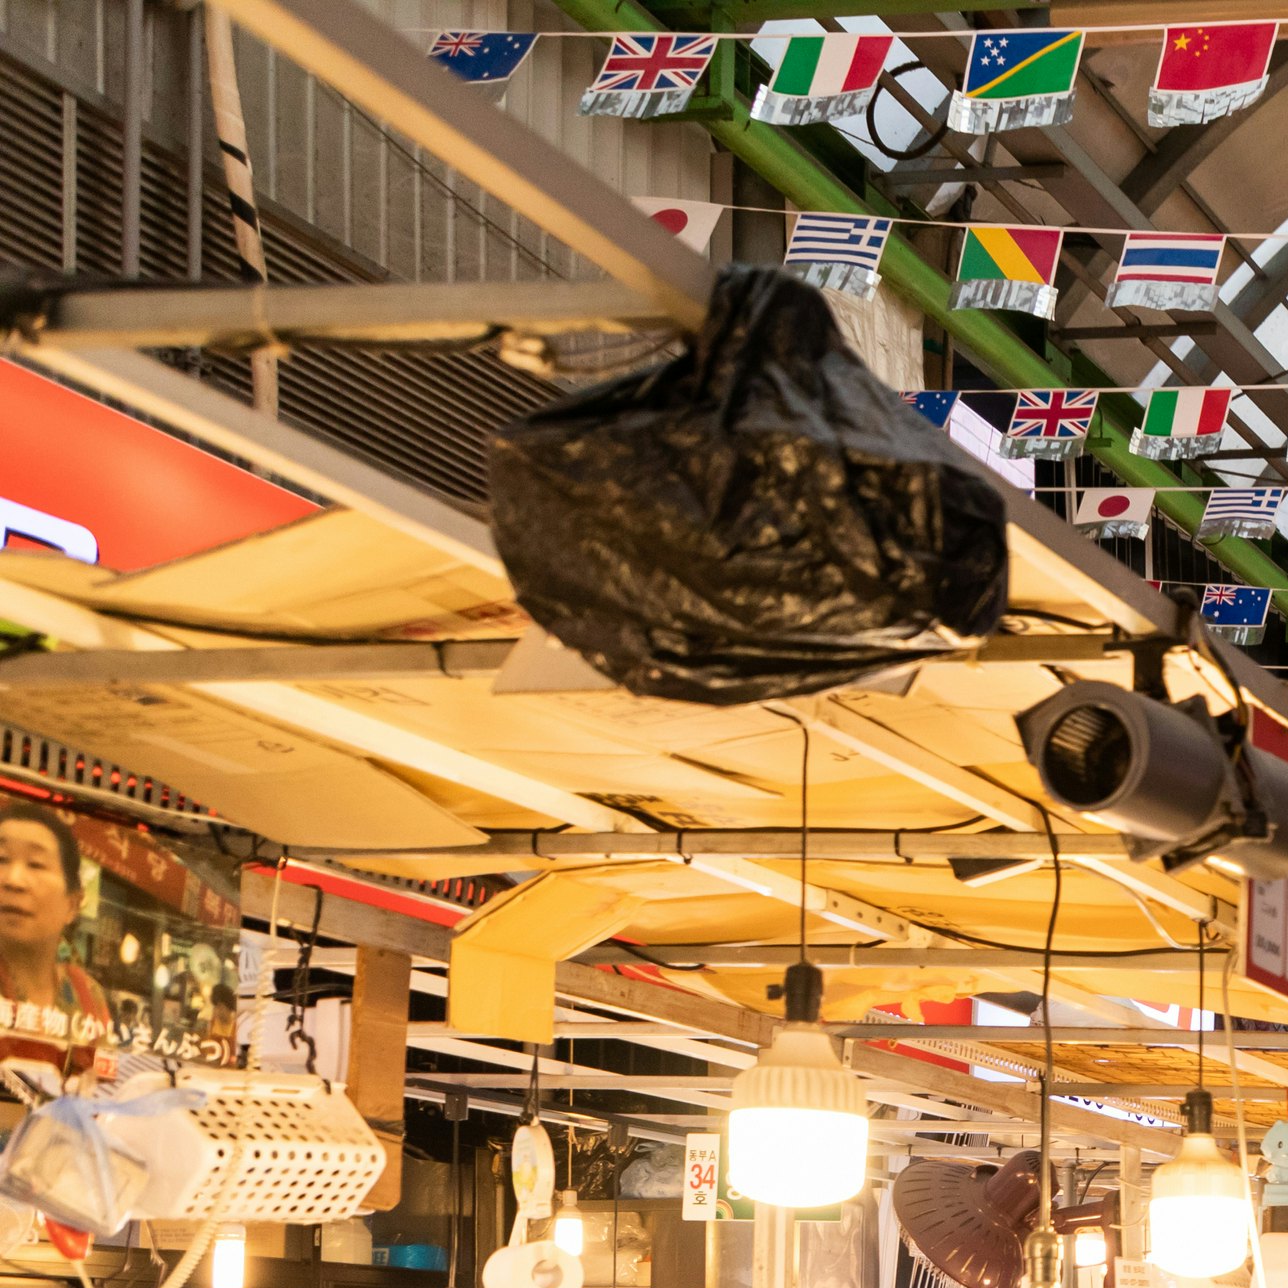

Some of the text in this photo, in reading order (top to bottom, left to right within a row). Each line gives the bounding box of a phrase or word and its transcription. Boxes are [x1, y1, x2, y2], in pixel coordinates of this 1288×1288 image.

[689, 1150, 717, 1162] 동부A
[690, 1164, 716, 1190] 34
[692, 1191, 708, 1206] 호
